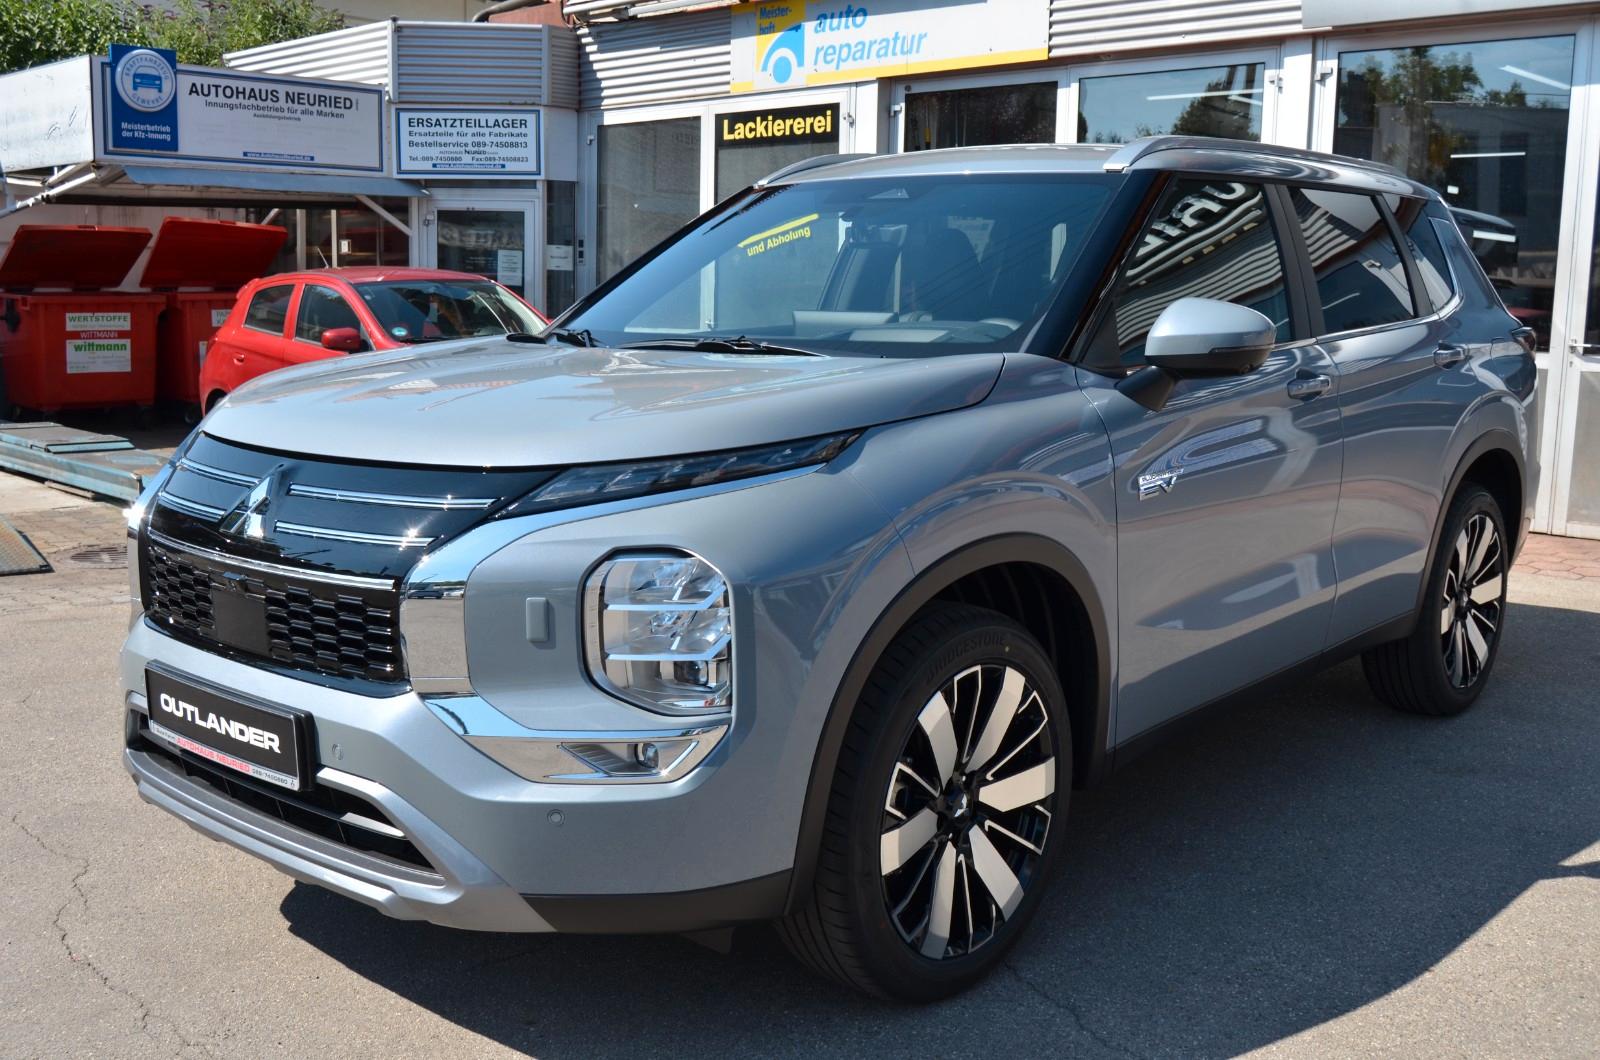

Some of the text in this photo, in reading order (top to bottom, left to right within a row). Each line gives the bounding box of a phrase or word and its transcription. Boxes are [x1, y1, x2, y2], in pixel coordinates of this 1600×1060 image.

[759, 6, 792, 20] Meister-
[813, 4, 868, 34] auto
[813, 30, 928, 70] reparatur
[188, 82, 280, 103] AUTOHAUS
[284, 90, 354, 110] NEURIED
[205, 100, 345, 119] Innungsfachbetrieb für alle Marken
[121, 121, 171, 133] Meisterbetrieb
[408, 117, 528, 129] ERSATZTEILLAGER
[723, 109, 832, 141] Lackiererei
[121, 130, 133, 138] der
[456, 130, 468, 138] für
[408, 140, 528, 149] Bestellservice 089-74508813
[747, 226, 811, 257] und Abholung
[73, 341, 128, 352] wittmann
[159, 692, 281, 754] OUTLANDER
